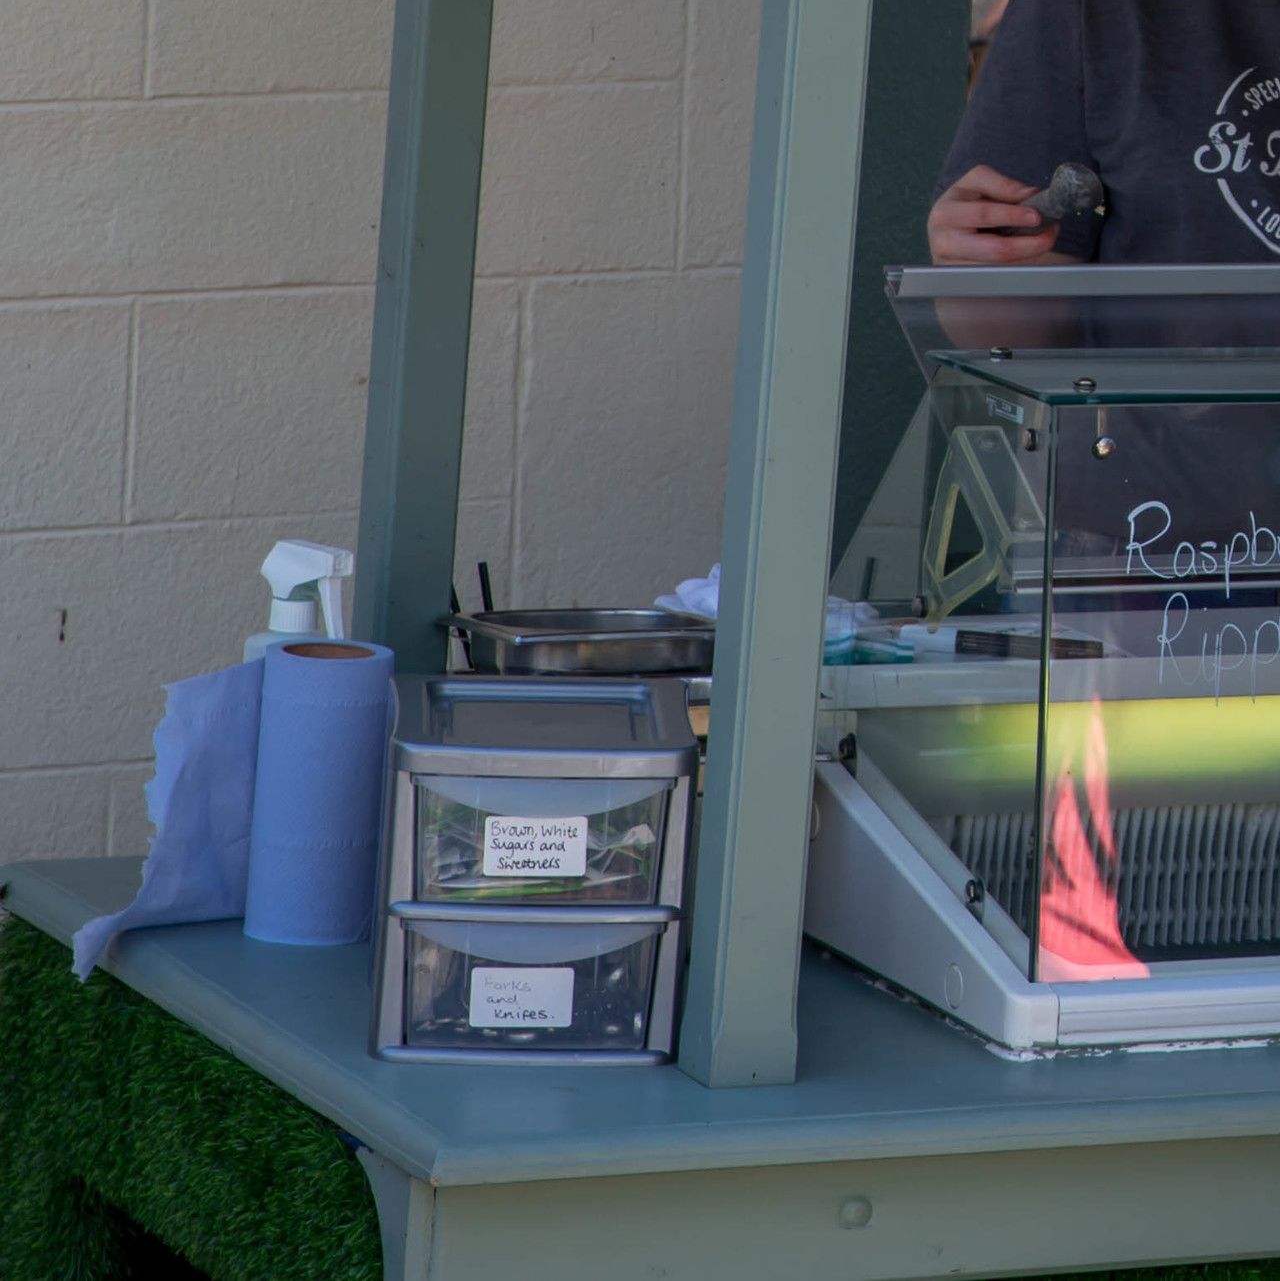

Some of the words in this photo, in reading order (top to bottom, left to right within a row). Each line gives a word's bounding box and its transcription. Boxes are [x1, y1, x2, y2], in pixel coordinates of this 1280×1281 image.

[1193, 121, 1254, 173] St
[490, 838, 535, 859] Sugars
[540, 841, 566, 852] and
